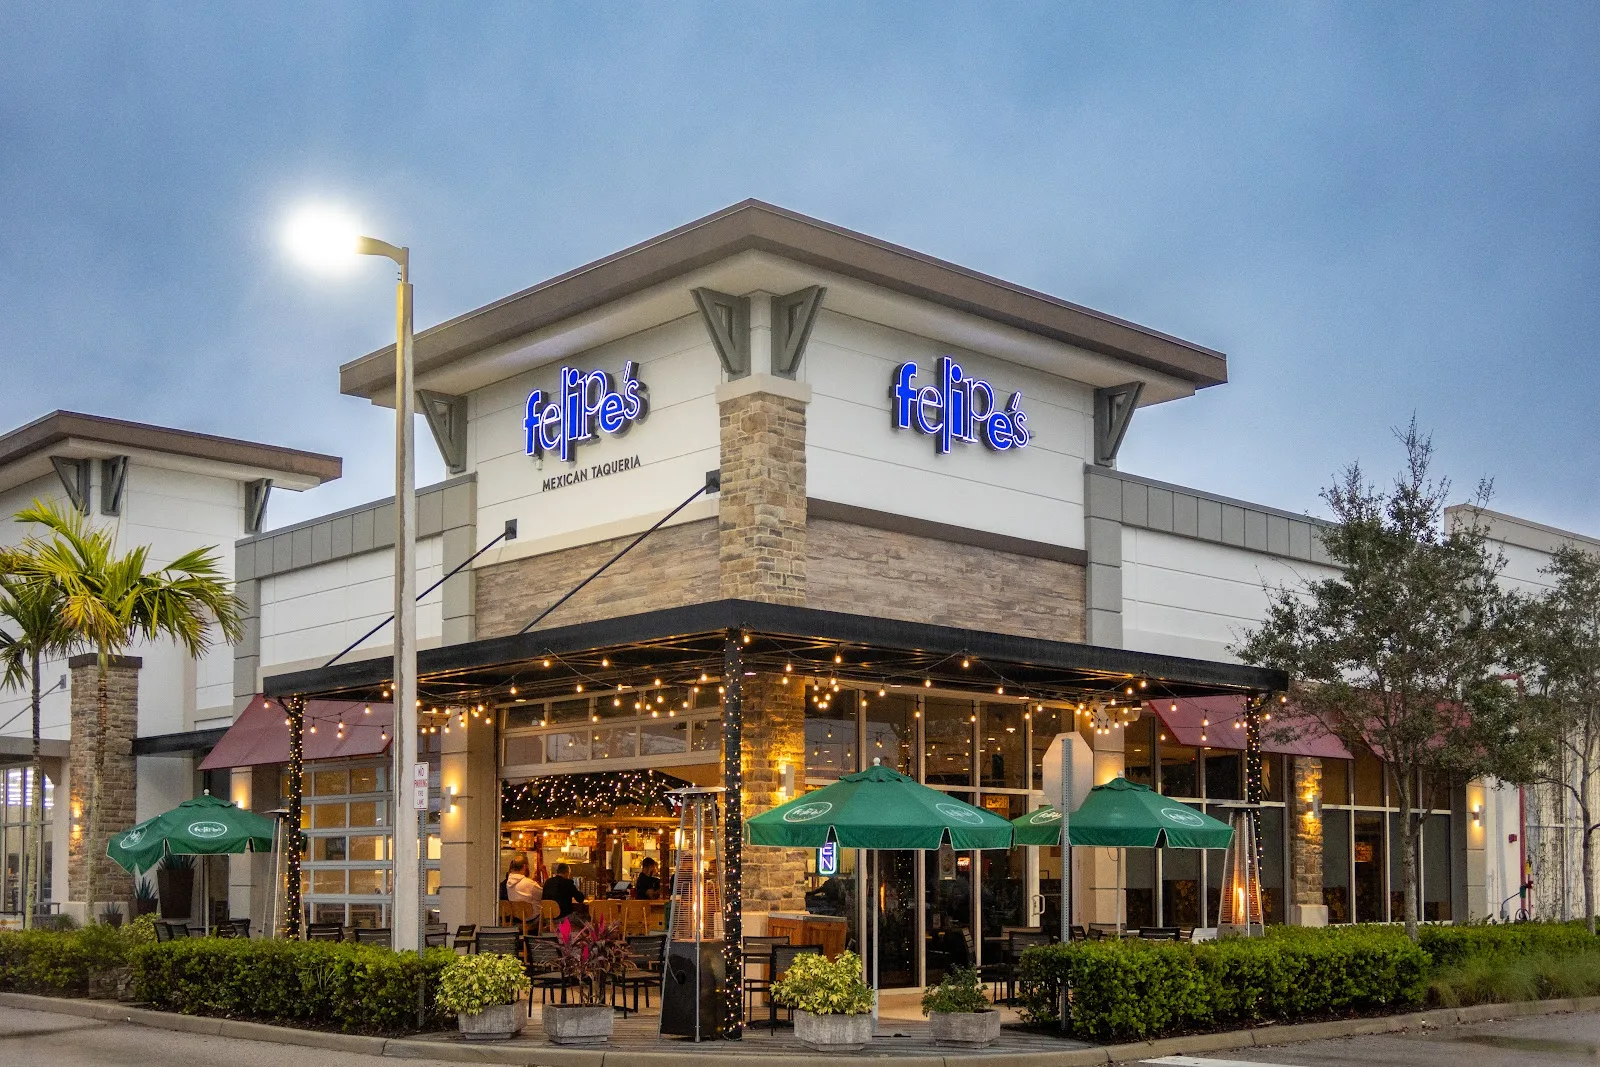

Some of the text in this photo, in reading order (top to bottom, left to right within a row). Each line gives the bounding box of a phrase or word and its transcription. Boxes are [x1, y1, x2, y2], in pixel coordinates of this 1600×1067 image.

[523, 360, 643, 462] felipe's
[895, 356, 1031, 454] felipe's
[543, 455, 641, 492] MEXICAN TAQUERIA
[414, 779, 428, 788] PARKING
[418, 767, 425, 777] NO
